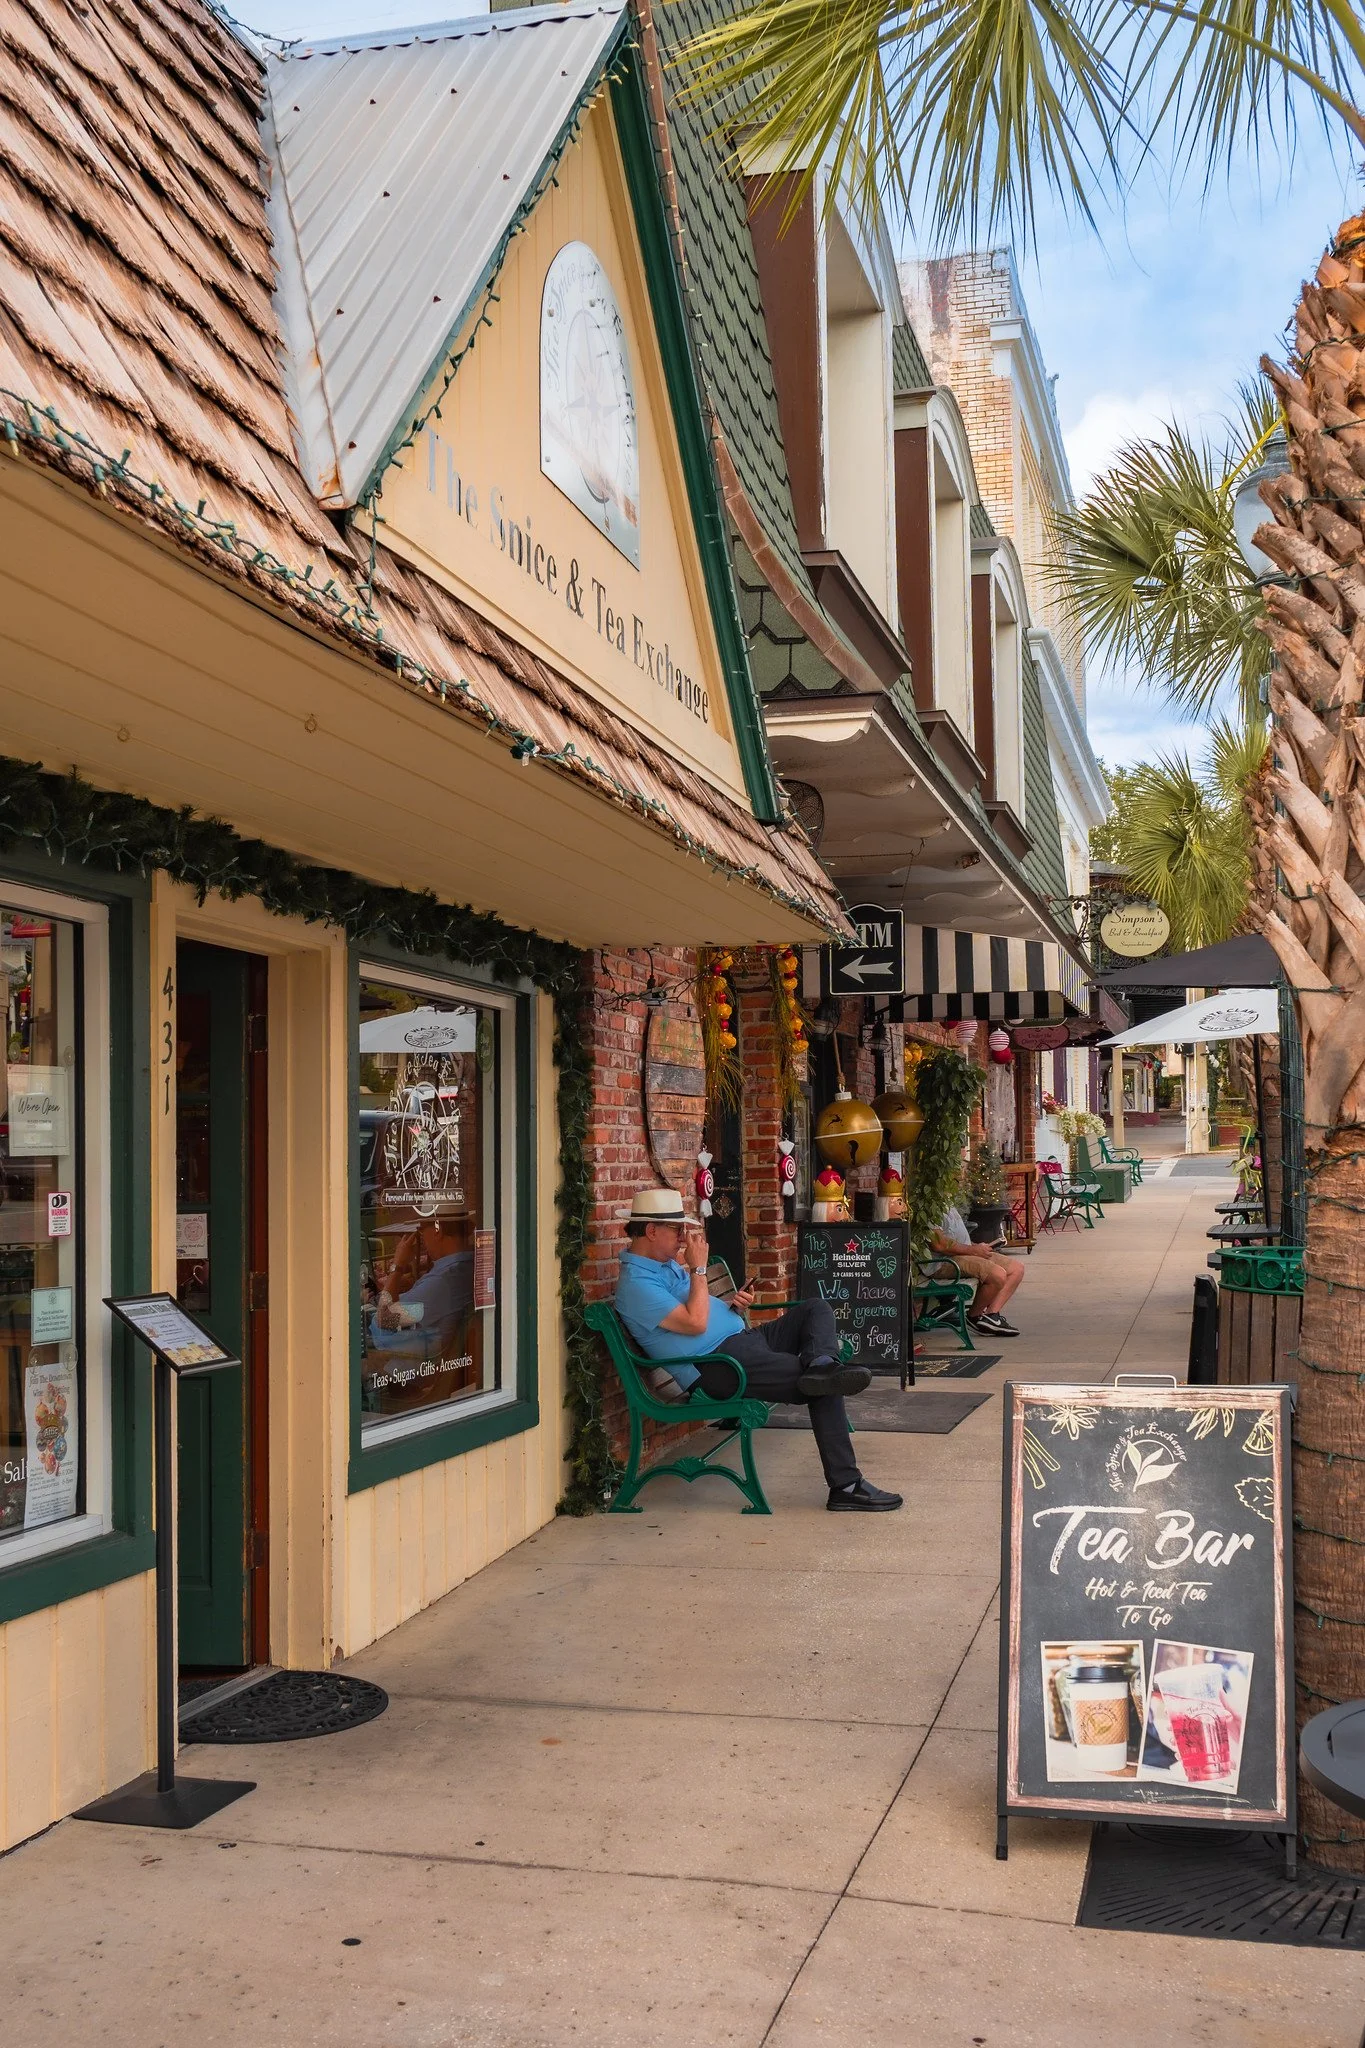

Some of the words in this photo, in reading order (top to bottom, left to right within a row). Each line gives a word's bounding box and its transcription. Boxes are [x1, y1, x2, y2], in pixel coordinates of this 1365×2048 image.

[421, 424, 478, 530] The
[566, 558, 585, 619] &
[591, 577, 626, 656] Tea
[632, 613, 709, 724] Exchange
[1110, 909, 1163, 928] Simpson's
[1108, 928, 1122, 937] Bed
[161, 966, 174, 1116] 431
[18, 1097, 40, 1114] We're
[42, 1097, 61, 1115] Open
[804, 1233, 827, 1252] The
[870, 1230, 882, 1239] at
[804, 1253, 829, 1269] Nest
[833, 1253, 870, 1261] Heineken
[818, 1280, 850, 1299] We
[857, 1280, 896, 1299] have
[372, 1373, 389, 1389] Teas
[392, 1368, 416, 1386] Sugars
[420, 1360, 435, 1377] Gifts
[440, 1353, 473, 1373] Accessories
[1124, 1425, 1145, 1440] Tea
[1146, 1421, 1187, 1462] Exchange
[1105, 1443, 1121, 1473] Spice
[1109, 1472, 1124, 1493] The
[1032, 1505, 1148, 1575] Tea
[1145, 1509, 1255, 1570] Bar
[1085, 1577, 1120, 1600] Hot
[1121, 1580, 1138, 1599] &
[1141, 1579, 1175, 1603] Iced
[1175, 1581, 1214, 1605] Tea
[1116, 1605, 1153, 1628] To
[1149, 1606, 1173, 1631] Go
